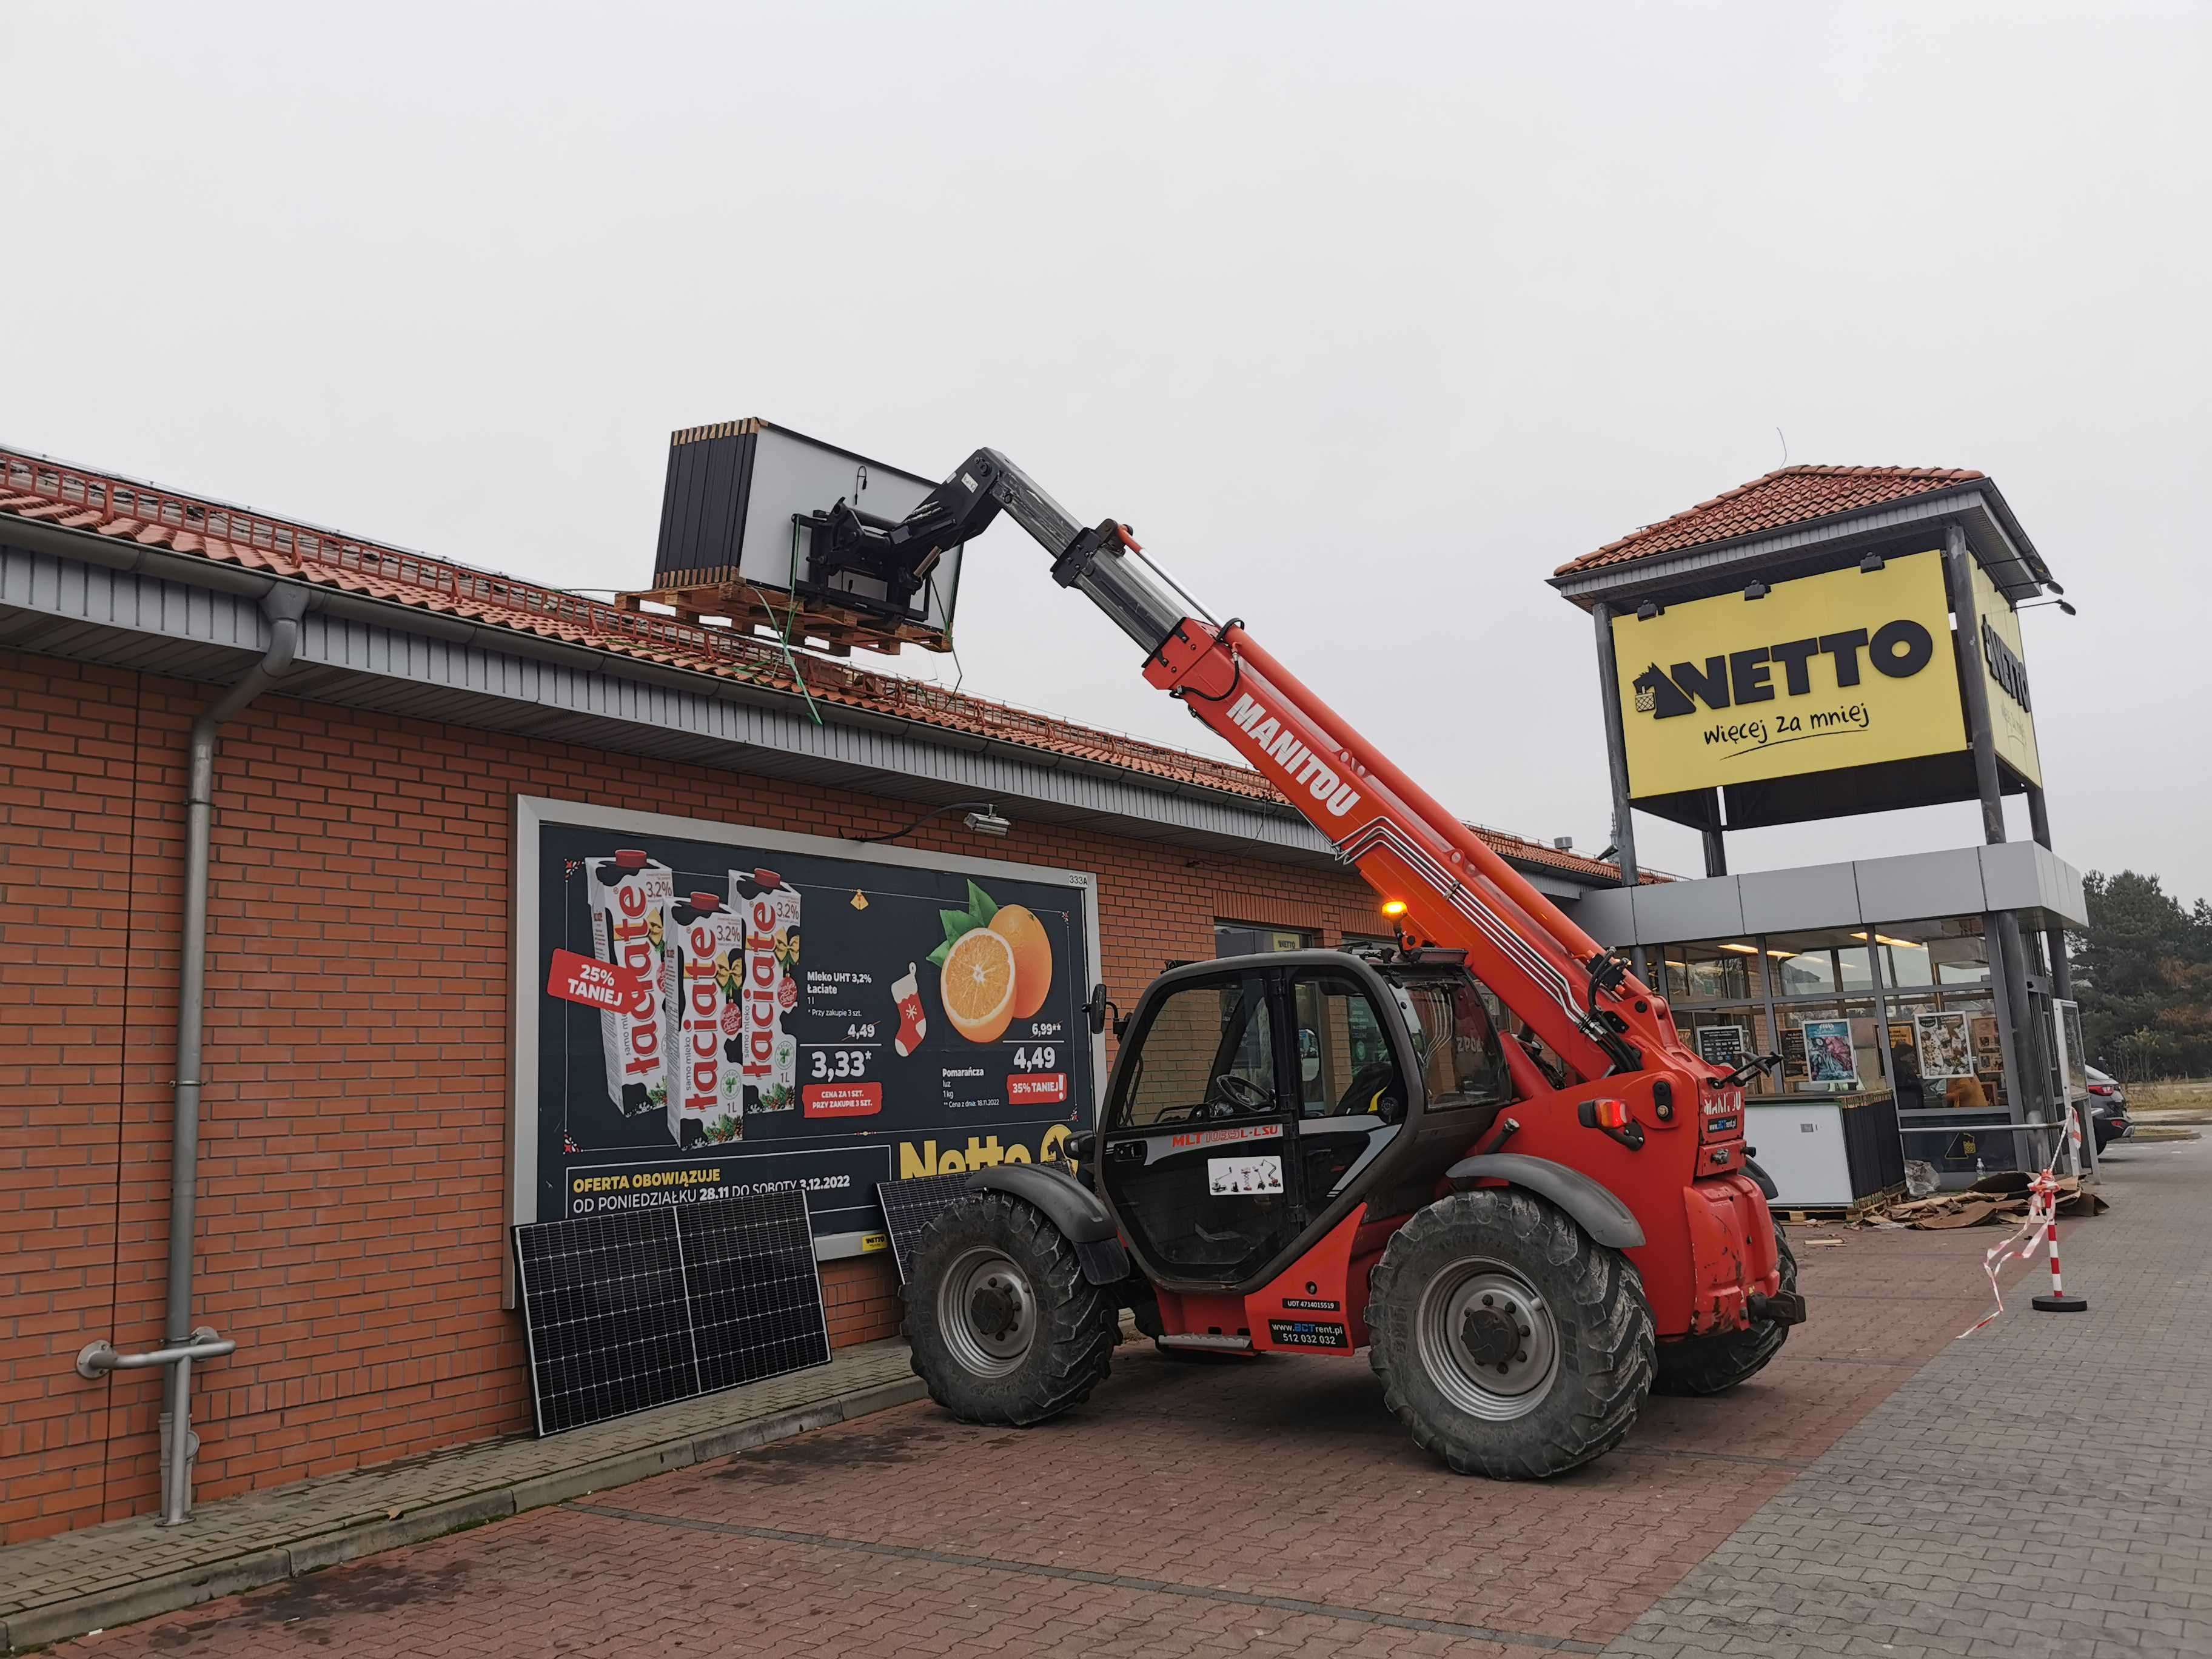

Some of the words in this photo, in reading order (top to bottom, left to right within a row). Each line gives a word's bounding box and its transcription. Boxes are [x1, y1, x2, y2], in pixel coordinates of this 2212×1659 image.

[1671, 620, 1932, 709] NETTO
[1810, 703, 1870, 728] mniej
[1226, 692, 1361, 816] MANITOU
[1069, 875, 1088, 885] 333A
[580, 964, 615, 987] 25%
[807, 971, 833, 981] Mleko
[833, 973, 851, 982] UHT
[851, 973, 872, 984] 3,2%
[568, 978, 623, 1007] TANIEJ
[806, 983, 837, 994] Łaciate
[825, 1009, 847, 1017] zakupie
[848, 1024, 875, 1040] 4,49
[623, 1032, 631, 1056] samo
[683, 1036, 692, 1065] mleko
[1013, 1047, 1055, 1073] 4,49
[942, 1067, 985, 1078] Pomarańcza
[1012, 1083, 1031, 1094] 35%
[899, 1135, 1031, 1179] Netto
[573, 1175, 629, 1193] OFERTA
[632, 1168, 720, 1187] OBOWIĄZUJE
[573, 1198, 595, 1213] OD
[598, 1189, 697, 1212] PONIEDZIAŁKU
[699, 1186, 729, 1201] 28.11
[732, 1184, 750, 1197] DO
[799, 1175, 850, 1191] 3.12.2022
[1300, 1301, 1335, 1309] 4714015519
[1282, 1333, 1299, 1342] 512
[1301, 1334, 1318, 1344] 032
[1319, 1335, 1336, 1345] 032
